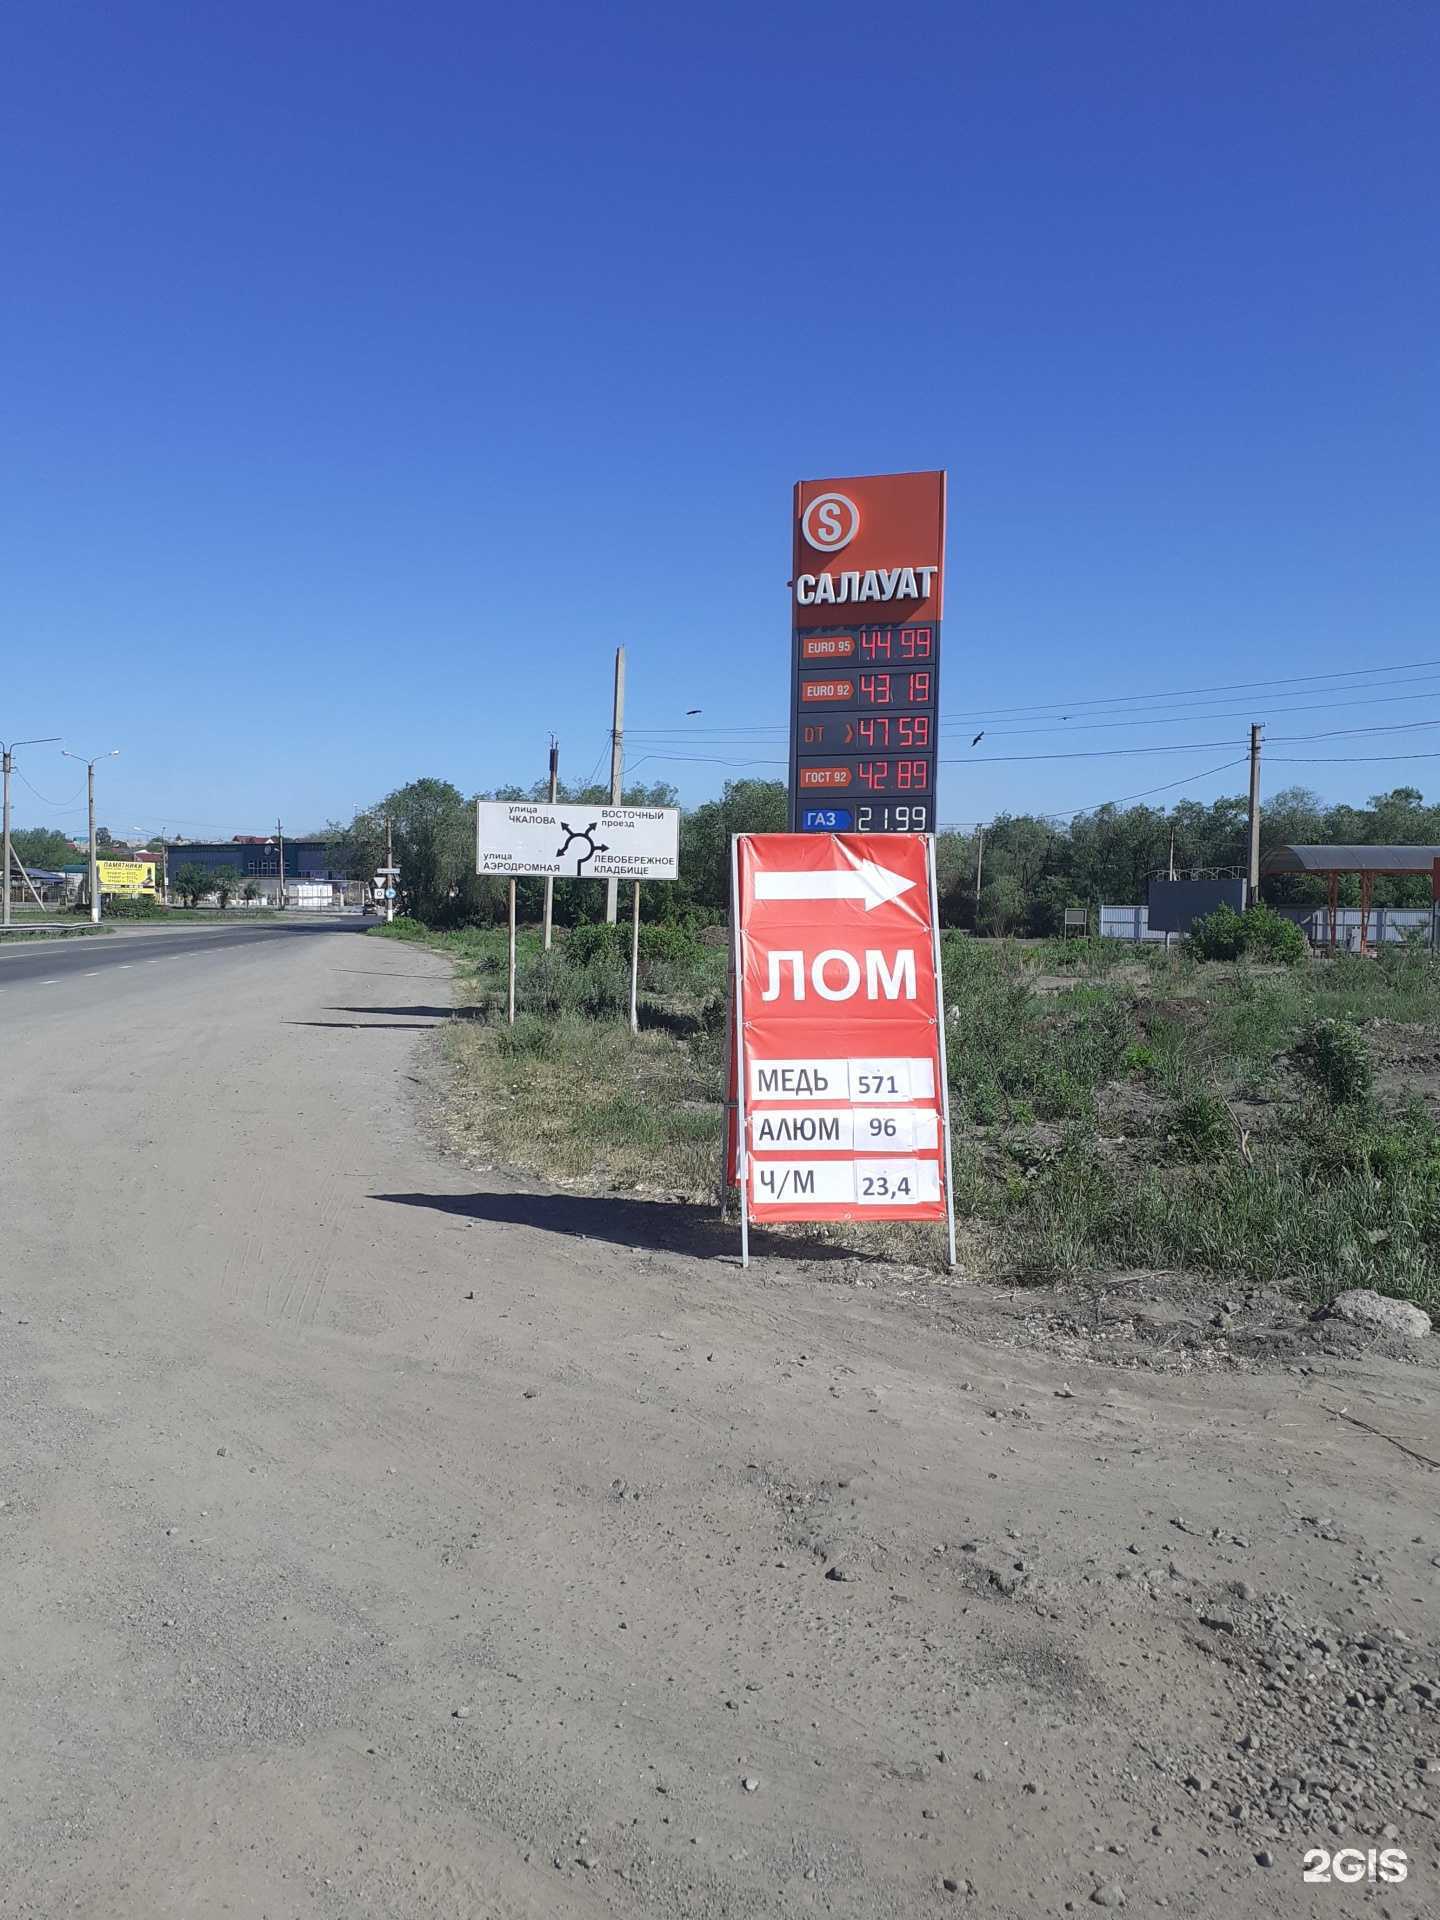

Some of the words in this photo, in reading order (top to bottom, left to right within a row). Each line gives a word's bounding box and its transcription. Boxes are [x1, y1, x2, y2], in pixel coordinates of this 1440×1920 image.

[818, 502, 842, 542] S
[796, 566, 938, 606] САЛАУАТ
[807, 642, 835, 653] EURO
[838, 640, 850, 651] 95
[807, 686, 834, 697] EURO
[836, 684, 849, 696] 92
[805, 772, 831, 783] ГОСТ
[834, 771, 847, 783] 92
[509, 806, 537, 814] улица
[602, 808, 664, 820] ВОСТОЧНЫЙ
[509, 815, 556, 825] ЧКАЛОВА
[602, 820, 635, 828] проезд
[807, 812, 836, 826] ГАЗ
[483, 853, 512, 861] улица
[594, 855, 675, 866] ЛЕВОБЕРЕЖНОЕ
[483, 862, 560, 873] АЭРОДРОМНАЯ
[594, 866, 649, 875] КЛАДБИЩЕ
[762, 949, 918, 1001] ЛОМ
[758, 1068, 829, 1096] МЕДЬ
[858, 1076, 899, 1094] 571
[759, 1117, 840, 1141] АЛЮМ
[869, 1118, 897, 1137] 96
[760, 1169, 816, 1200] Ч/М
[862, 1176, 911, 1201] 23,4
